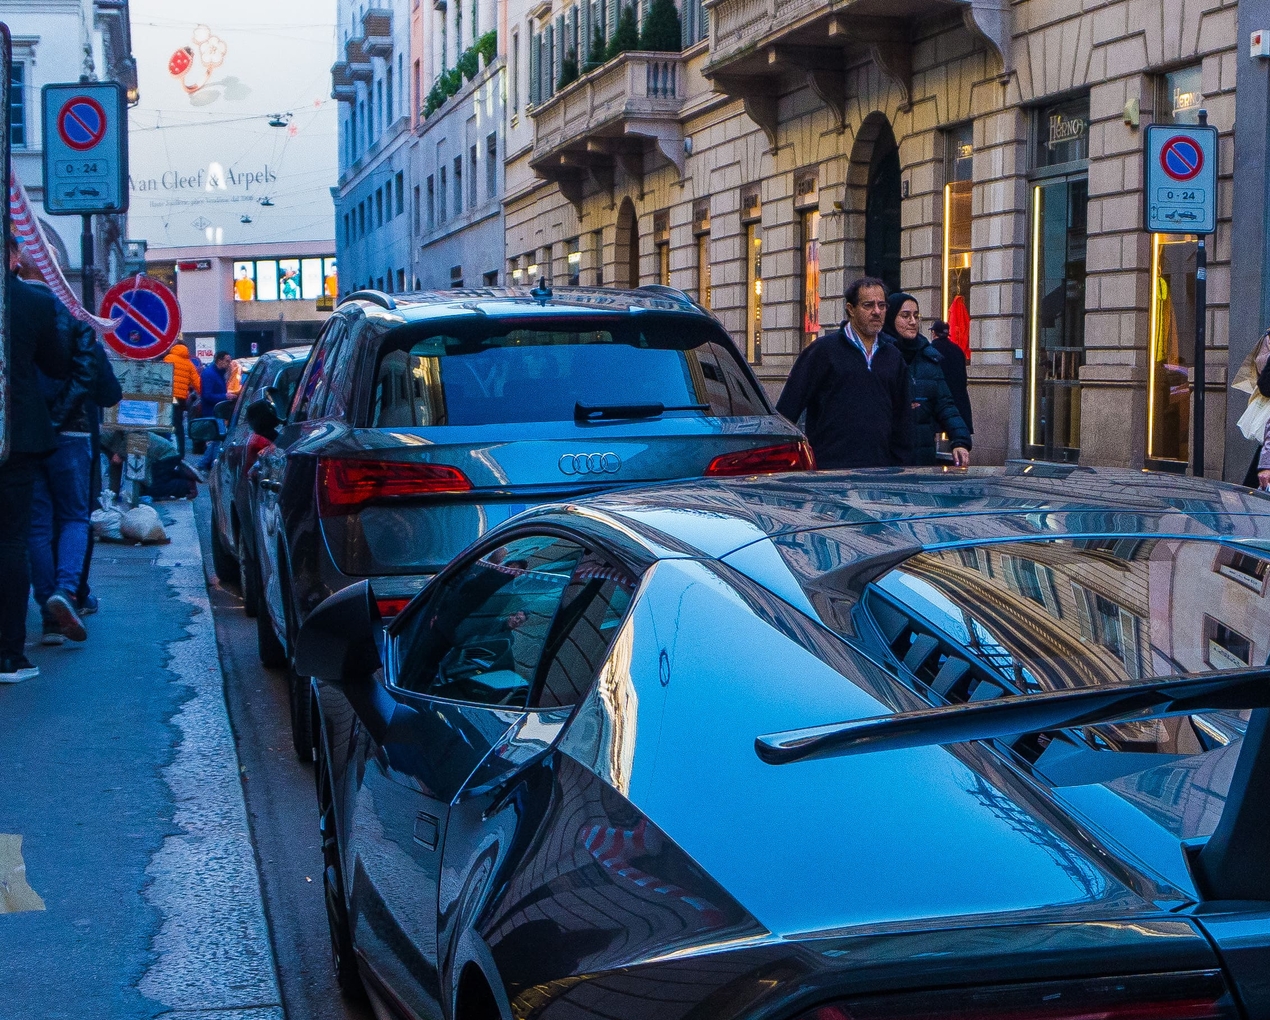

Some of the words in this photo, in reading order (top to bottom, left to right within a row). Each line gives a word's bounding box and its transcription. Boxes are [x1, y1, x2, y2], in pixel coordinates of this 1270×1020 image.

[83, 163, 98, 173] 24
[127, 174, 157, 191] Van
[161, 168, 205, 190] Cleef
[209, 172, 219, 187] &
[227, 164, 276, 190] Arpels
[1167, 191, 1173, 199] 0
[1182, 191, 1195, 199] 24
